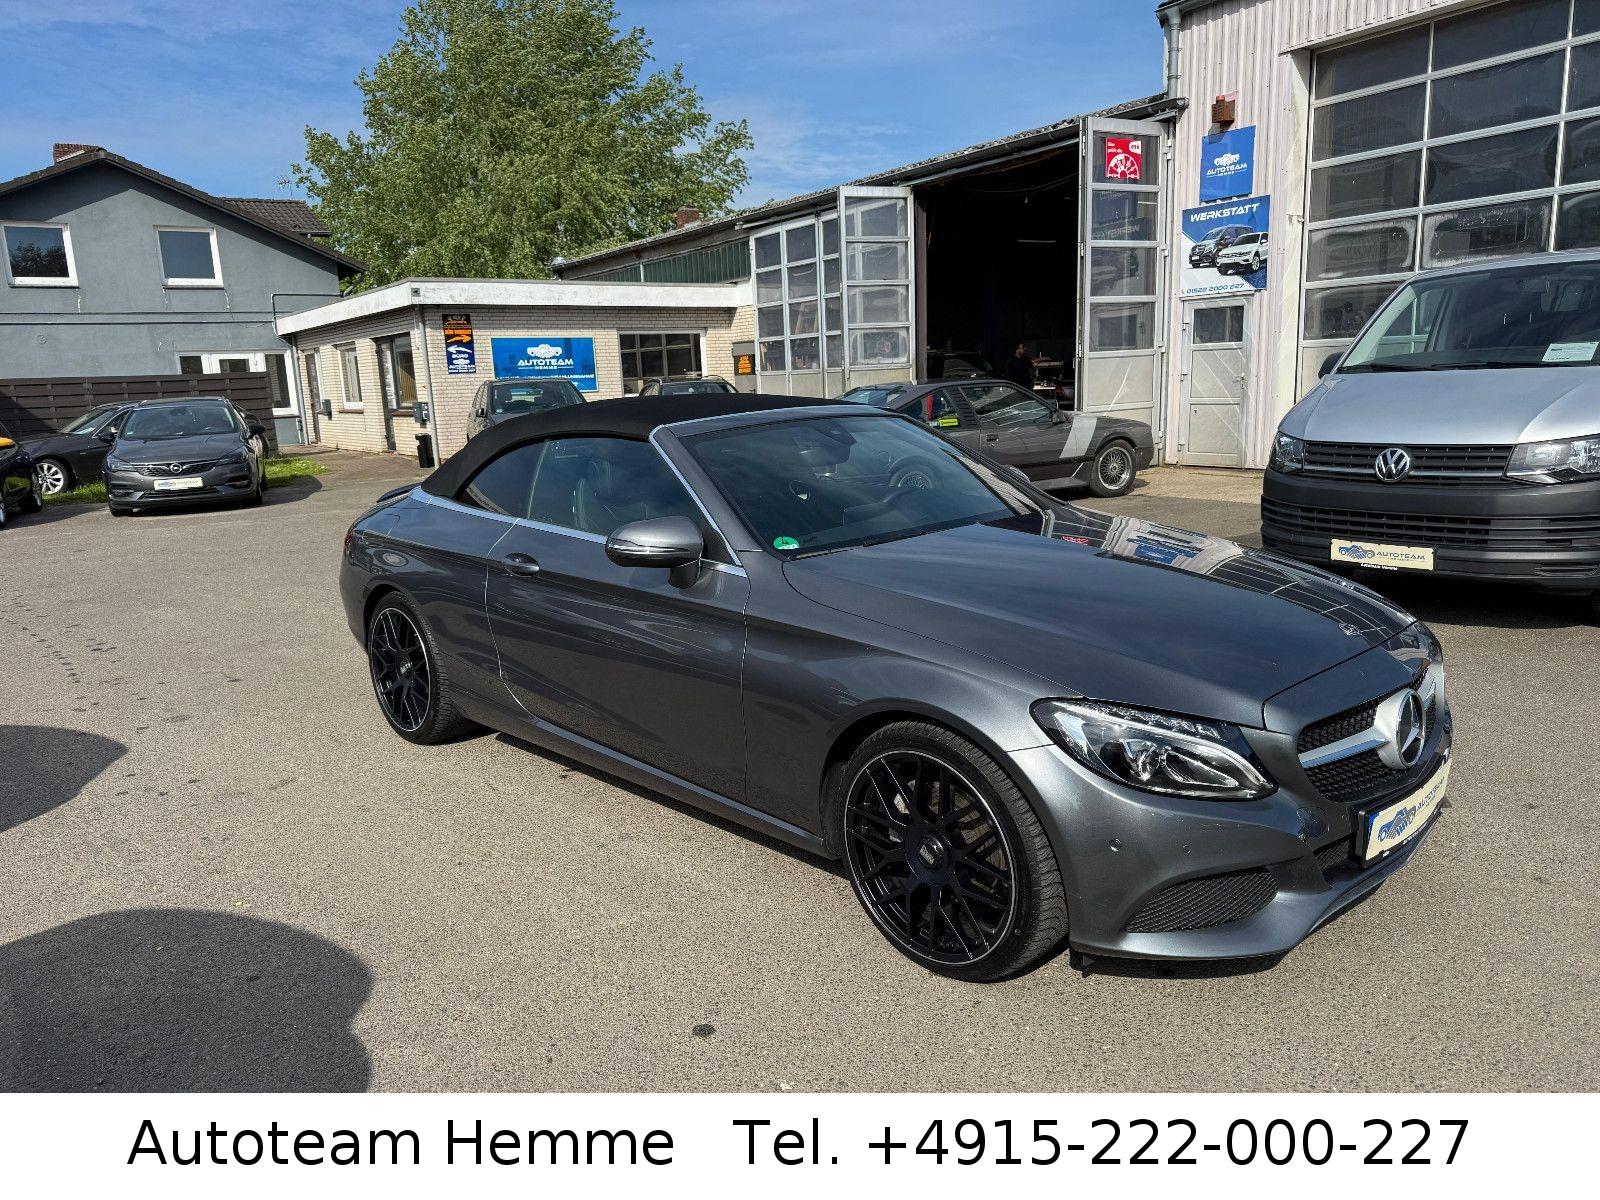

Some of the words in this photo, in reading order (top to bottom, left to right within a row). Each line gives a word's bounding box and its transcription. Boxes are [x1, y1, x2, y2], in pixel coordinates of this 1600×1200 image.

[1206, 163, 1248, 176] AUTOTEAM
[1190, 202, 1260, 223] WERKSTATT
[517, 358, 574, 367] AUTOTEAM
[1376, 550, 1426, 561] AUTOTEAM
